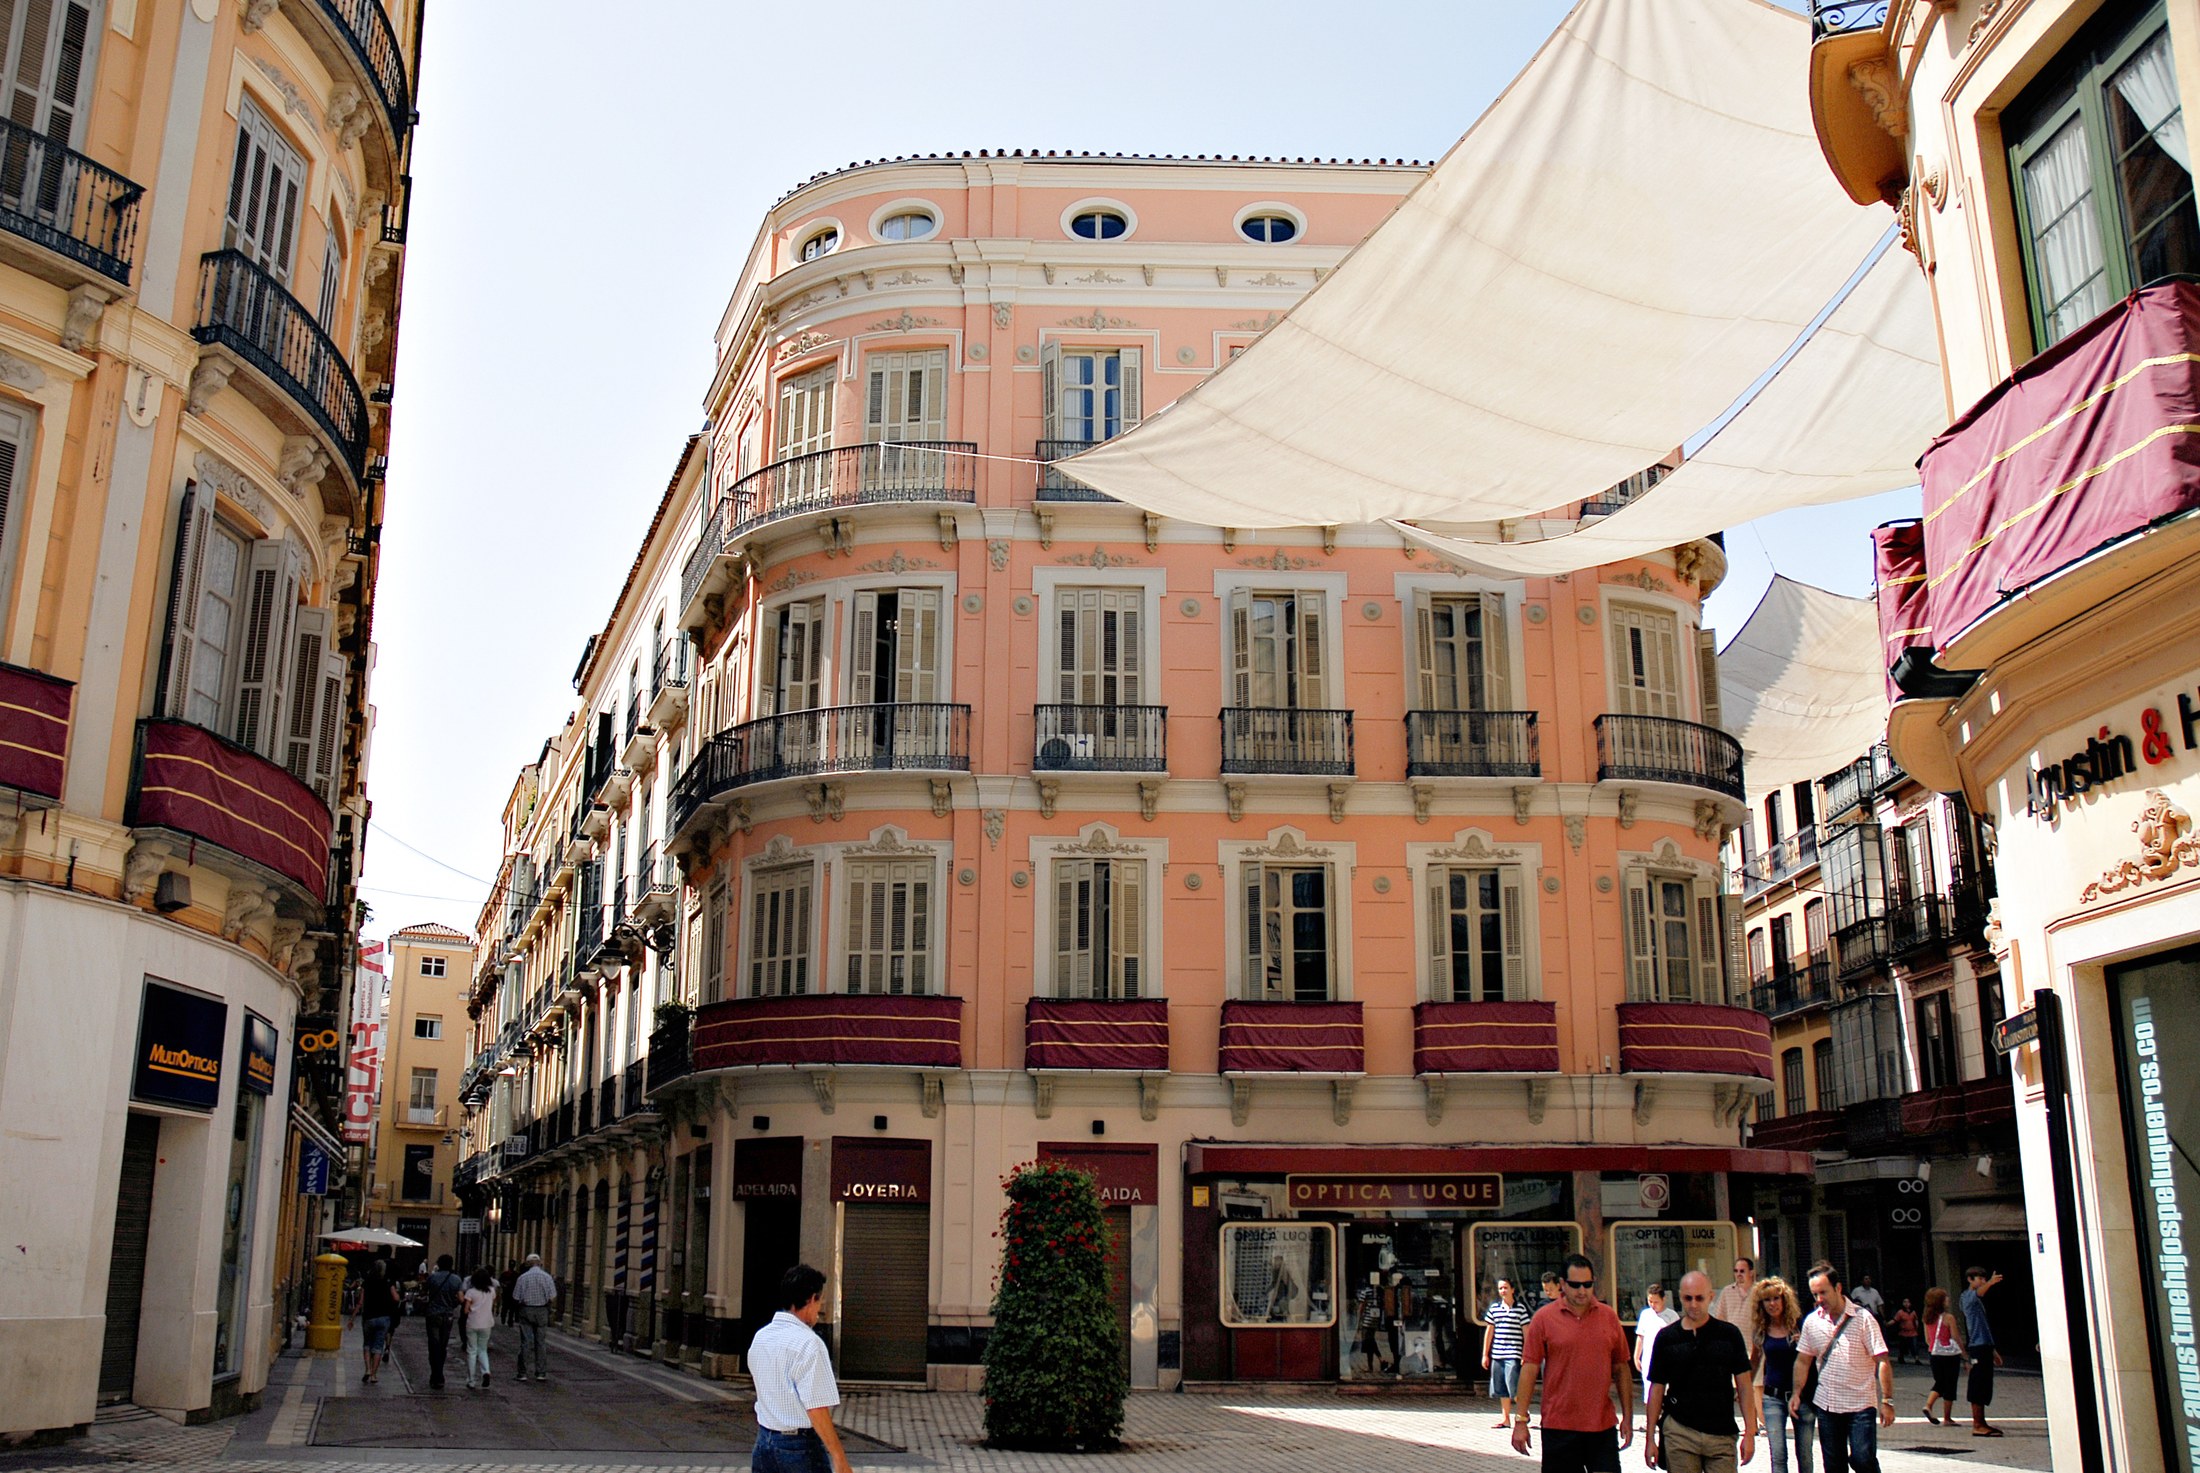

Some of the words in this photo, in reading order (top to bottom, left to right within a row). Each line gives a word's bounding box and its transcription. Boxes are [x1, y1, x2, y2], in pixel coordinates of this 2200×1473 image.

[2026, 725, 2137, 822] Agustín
[2140, 707, 2174, 765] &
[735, 1182, 797, 1196] ADELAIDA
[842, 1182, 919, 1198] JOYERIA
[1296, 1183, 1393, 1200] OPTICA
[1408, 1183, 1493, 1200] LUQUE
[1482, 1231, 1527, 1242] OPTICA
[1635, 1229, 1679, 1240] OPTICA
[1692, 1228, 1715, 1239] LUQUE
